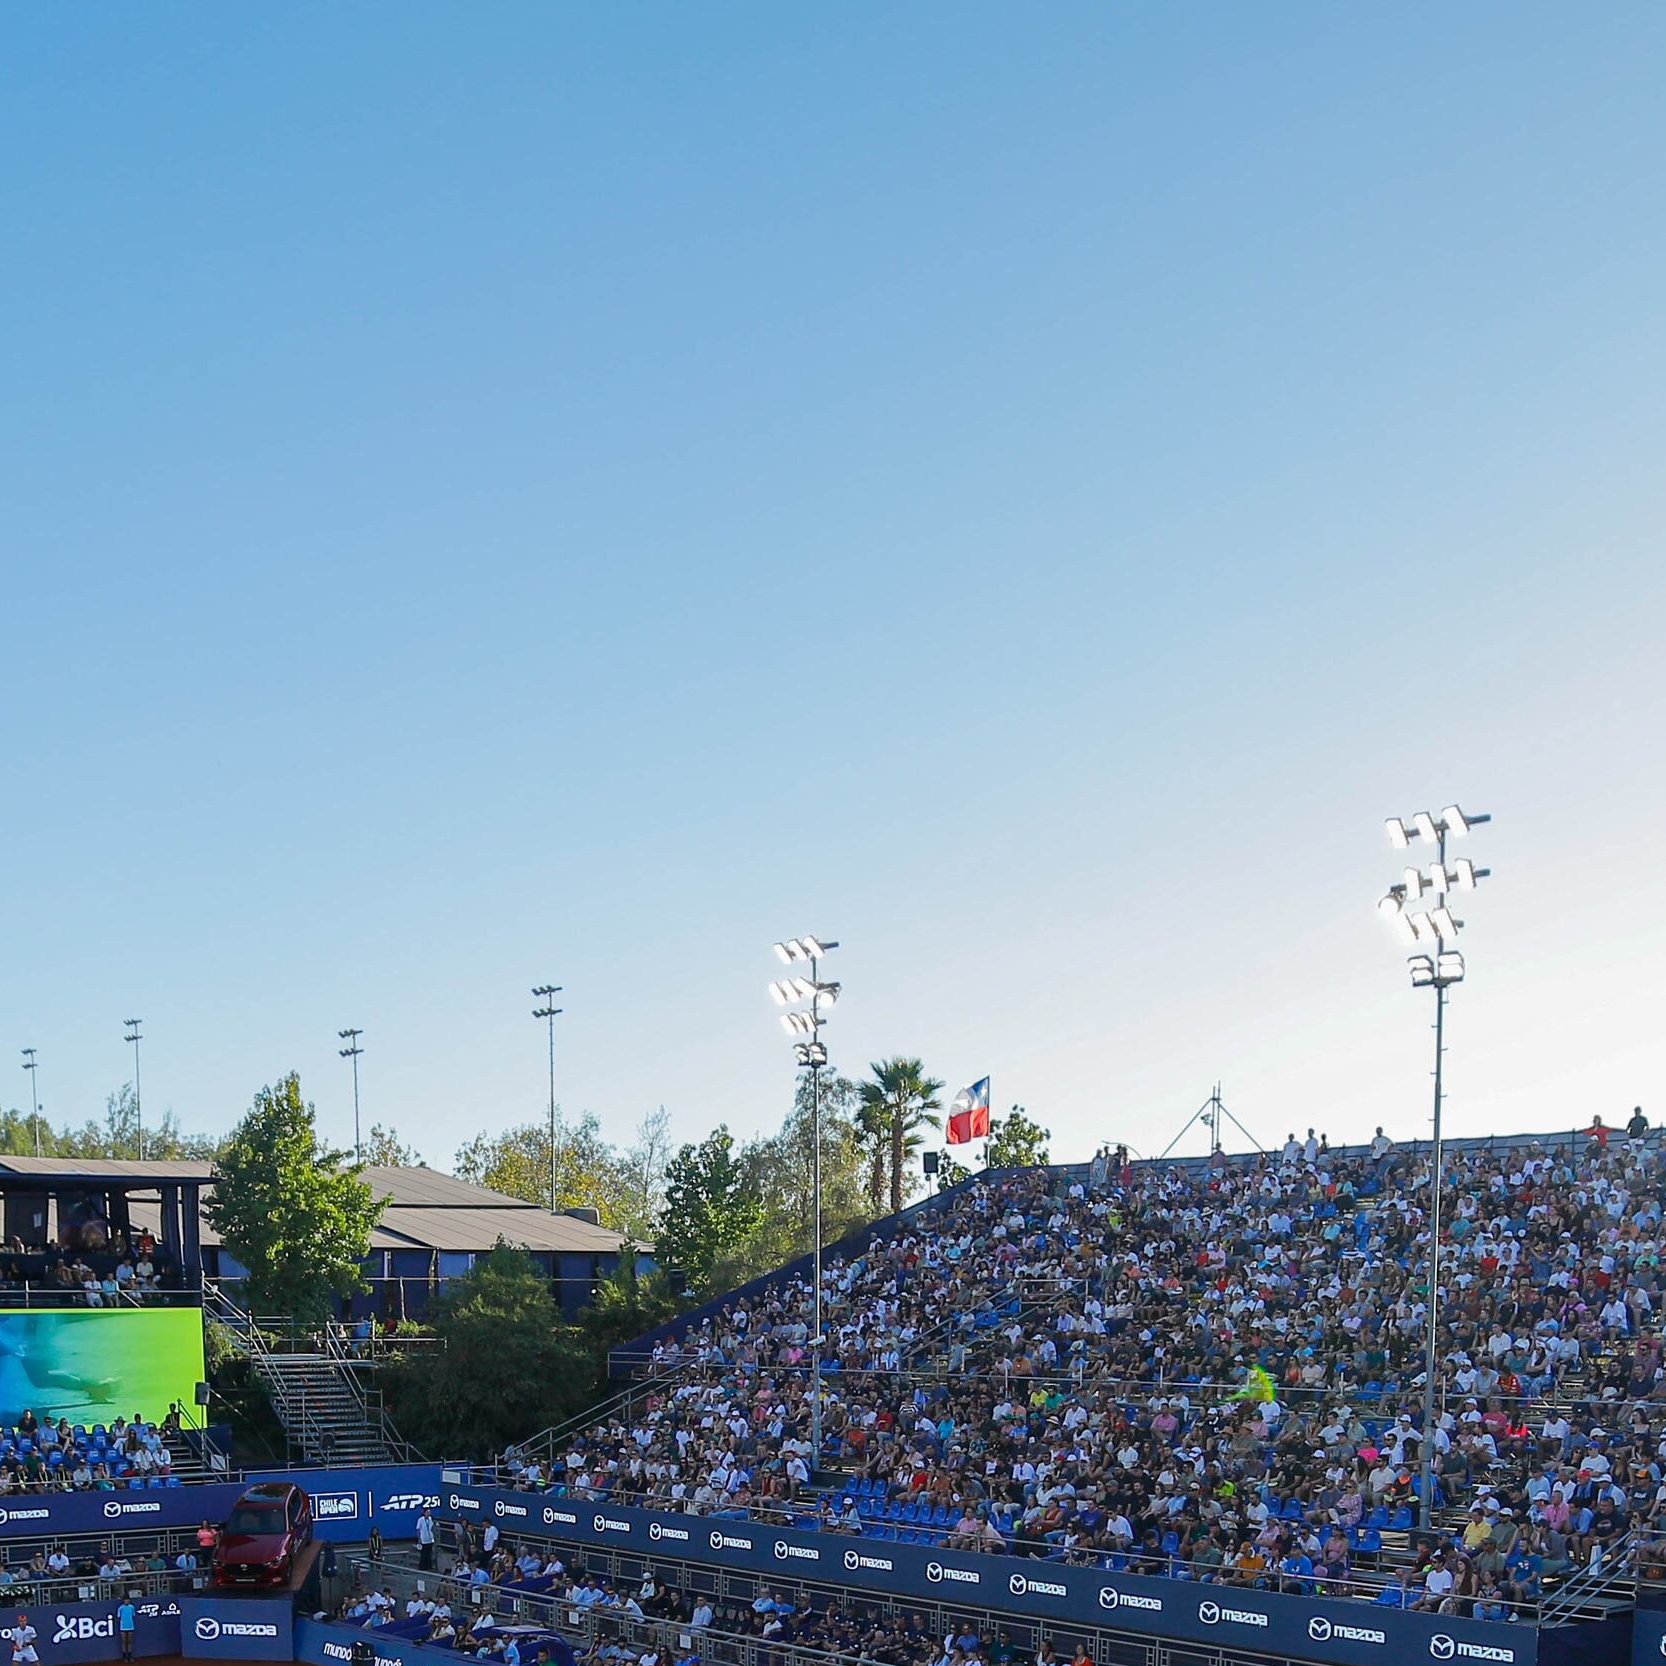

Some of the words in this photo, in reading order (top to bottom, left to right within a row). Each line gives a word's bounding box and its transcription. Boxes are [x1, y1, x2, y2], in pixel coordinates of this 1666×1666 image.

[380, 1495, 423, 1511] ATP
[788, 1545, 820, 1560] mazda
[857, 1556, 893, 1572] mazda
[941, 1567, 981, 1584] mazda
[1027, 1580, 1067, 1596] mazda
[1118, 1593, 1162, 1611] mazda
[1220, 1608, 1269, 1628] mazda
[79, 1615, 114, 1639] Bci
[222, 1622, 277, 1637] mazda
[1333, 1623, 1386, 1644] mazda
[1456, 1641, 1515, 1664] mazda
